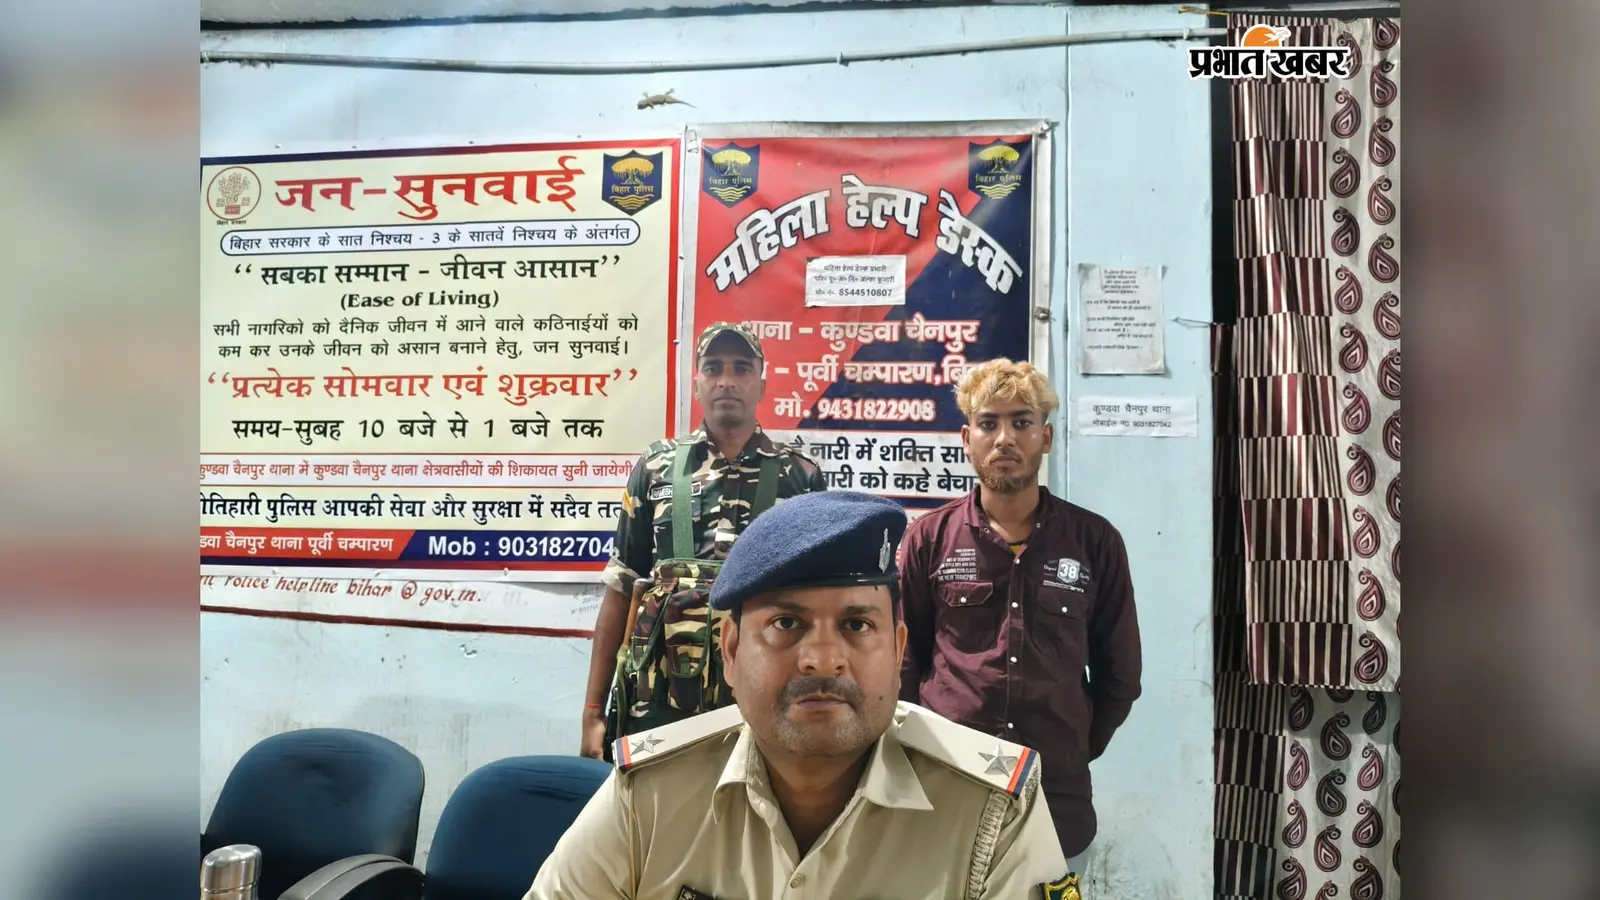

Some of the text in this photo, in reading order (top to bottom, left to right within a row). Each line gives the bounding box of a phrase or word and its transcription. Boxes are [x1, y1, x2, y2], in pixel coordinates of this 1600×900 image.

[275, 155, 585, 221] जन-सुनवाई
[230, 235, 261, 250] बिहार
[269, 235, 310, 248] सरकार
[318, 232, 330, 247] के
[338, 235, 363, 246] सात
[371, 231, 412, 246] निश्चय
[432, 233, 440, 244] 3
[448, 228, 461, 243] के
[469, 226, 505, 242] सातवें
[513, 227, 556, 241] निश्चय
[565, 225, 577, 240] के
[585, 224, 630, 240] अंतर्गत
[705, 173, 1024, 295] महिला हेल्प डेस्क
[261, 266, 328, 285] सबका
[334, 263, 410, 283] सम्मान
[440, 254, 506, 280] जीवन
[341, 290, 500, 311] (Ease of Living)
[839, 288, 892, 297] 8544510807
[213, 313, 638, 336] सभी नागरिको को दैनिक जीवन में आने वाले कठिनाईयों को
[820, 320, 901, 351] कुण्डवा
[904, 312, 980, 352] चैनपुर
[218, 336, 629, 359] कम कर उनके जीवन को असान बनाने हेतु, जन सुनवाई।
[323, 366, 433, 397] सोमवार
[442, 365, 488, 400] एवं
[796, 354, 840, 391] पूर्वी
[844, 355, 980, 386] चम्पारण,बि
[774, 391, 936, 420] मो. 9431822908
[1093, 403, 1171, 415] कुण्डवा चैनपुर थाना
[232, 411, 604, 445] समय-सुबह 10 बजे से 1 बजे तक
[810, 436, 851, 461] नारी
[856, 438, 877, 461] में
[879, 438, 936, 463] शक्ति
[940, 446, 967, 464] सा
[232, 459, 266, 481] चैनपुर
[270, 464, 294, 477] थाना
[298, 460, 309, 476] में
[313, 464, 349, 481] कुण्डवा
[353, 460, 386, 481] चैनपुर
[391, 464, 418, 477] थाना
[422, 460, 483, 477] क्षेत्रवासीयों
[487, 461, 503, 477] की
[508, 460, 558, 477] शिकायत
[562, 460, 588, 481] सुनी
[593, 460, 632, 477] जायेगी
[860, 467, 888, 490] को
[893, 467, 931, 492] कहे
[937, 466, 980, 492] बेचा
[200, 491, 622, 525] ोतिहारी पुलिस आपकी सेवा और सुरक्षा में सदैव तत
[200, 530, 394, 556] डवा चैनपुर थाना पूर्वी चम्पारण
[428, 536, 477, 556] Mob
[498, 536, 614, 557] 903182704
[1060, 563, 1077, 579] 38
[276, 576, 338, 594] helpline
[347, 578, 392, 597] bihar
[401, 580, 418, 600] @
